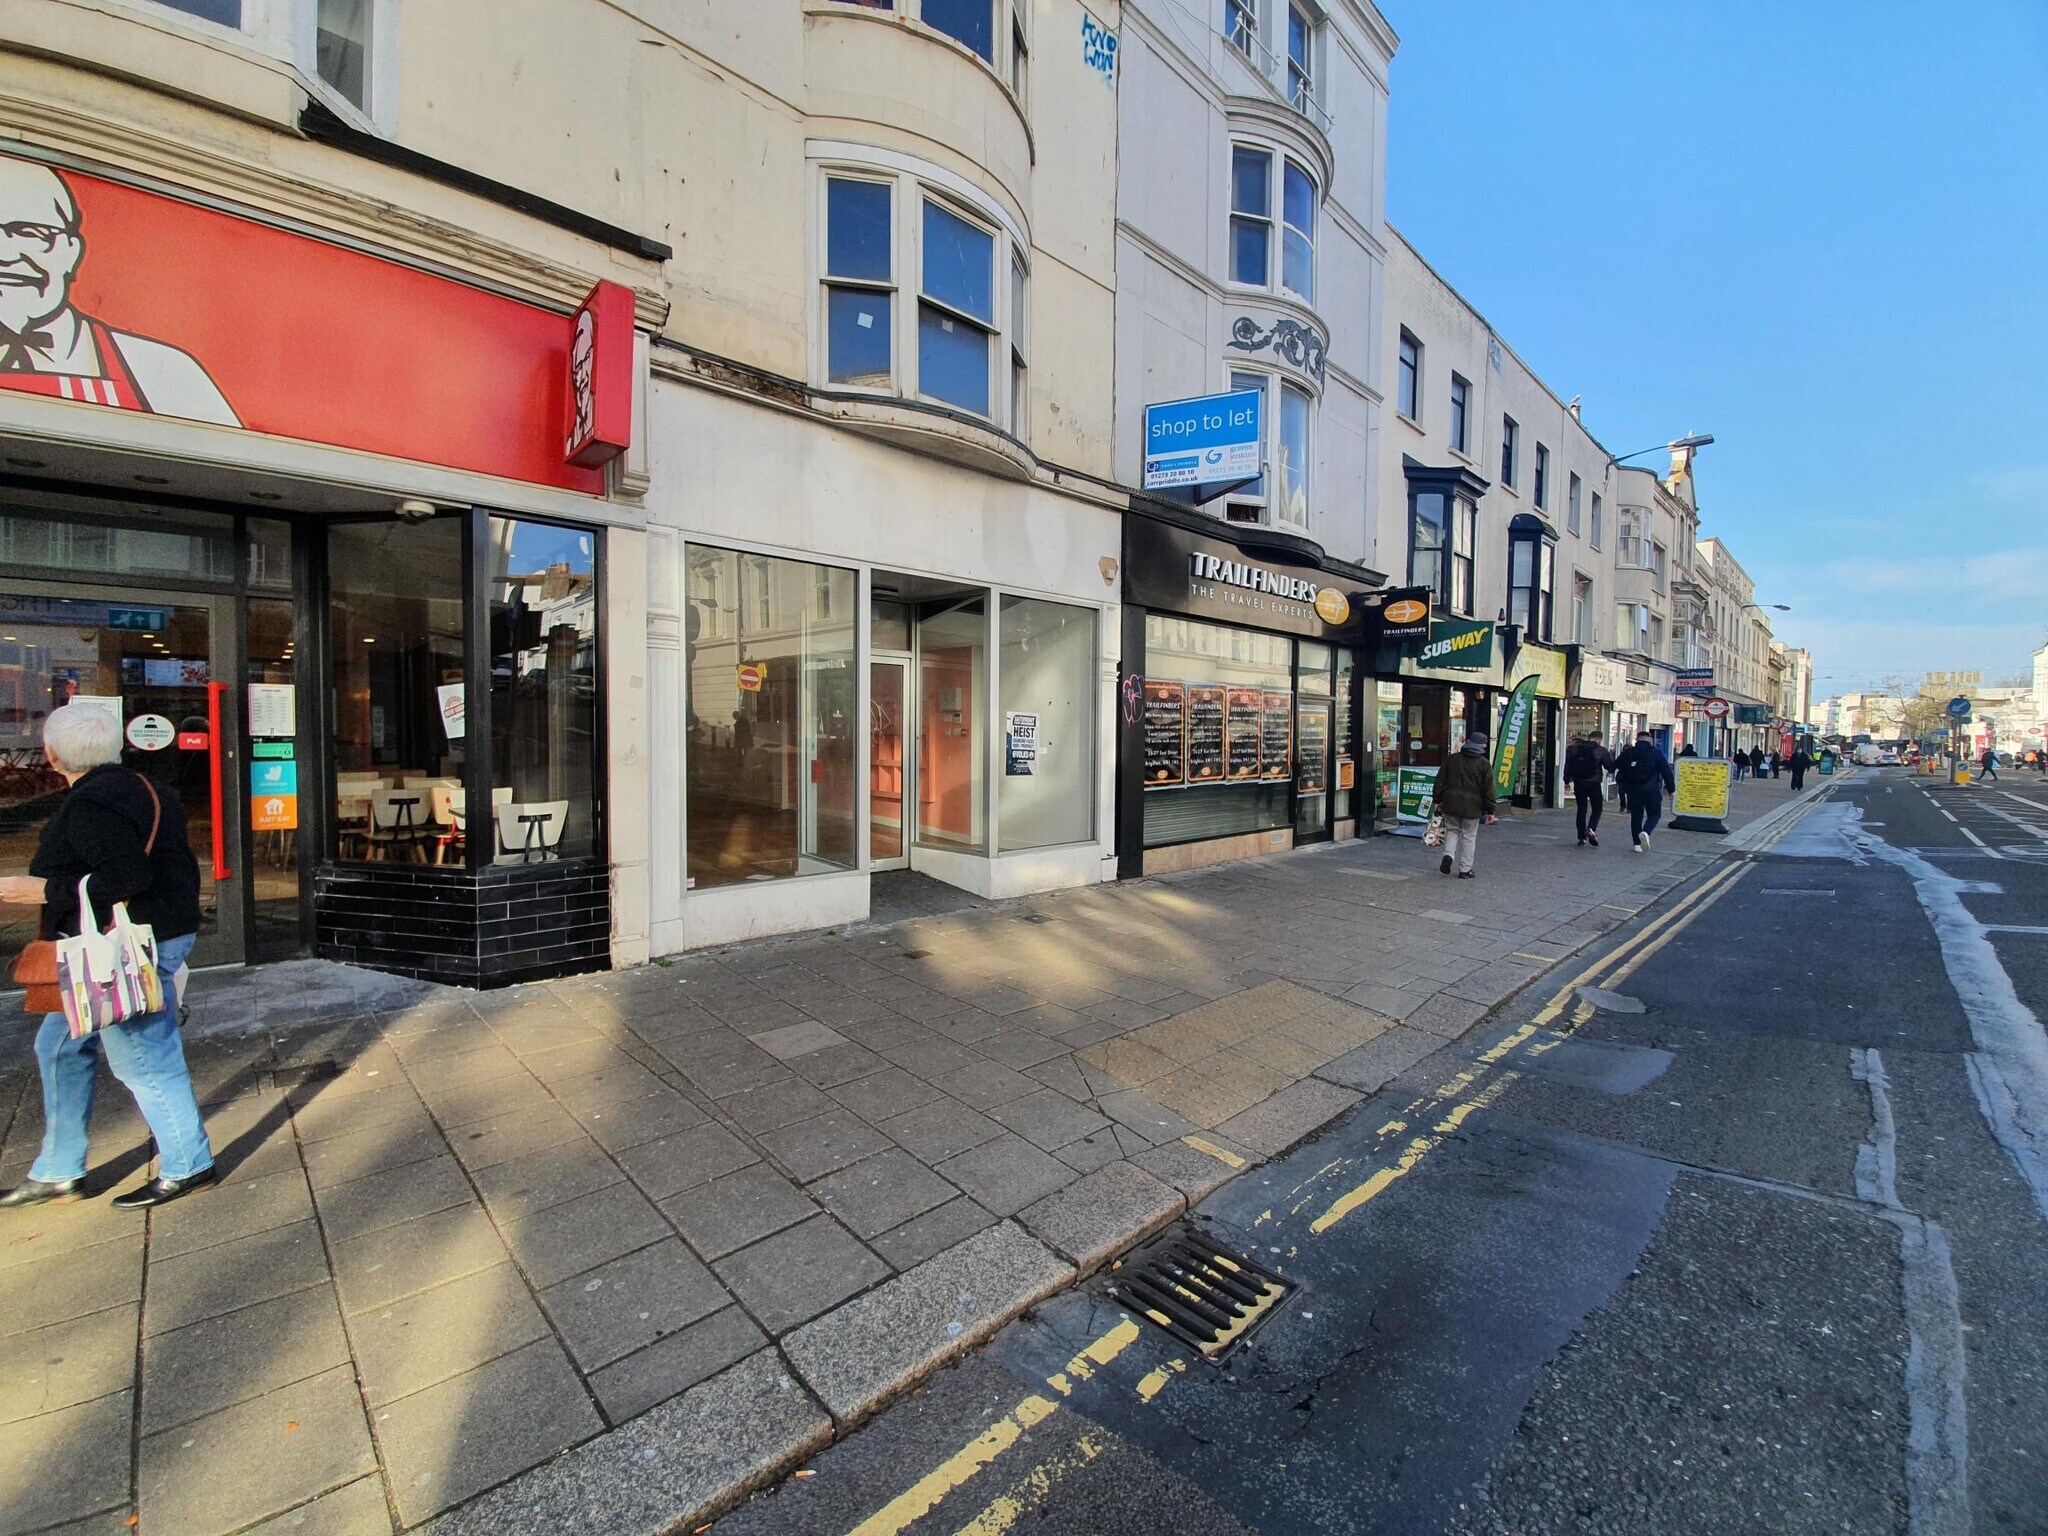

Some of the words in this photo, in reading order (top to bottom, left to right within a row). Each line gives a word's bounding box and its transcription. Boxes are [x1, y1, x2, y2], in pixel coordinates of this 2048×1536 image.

[1152, 419, 1197, 437] shop
[1202, 413, 1222, 430] to
[1229, 408, 1254, 427] let
[1191, 551, 1317, 603] TRAILFINDERS
[1192, 584, 1215, 599] THE
[1223, 591, 1264, 609] TRAVEL
[1271, 602, 1313, 620] EXPERTS
[1383, 627, 1426, 635] TRAILFINDERS
[1421, 627, 1489, 660] SUBWAY
[1013, 727, 1035, 738] HEIST
[1498, 692, 1527, 788] SUBWAY
